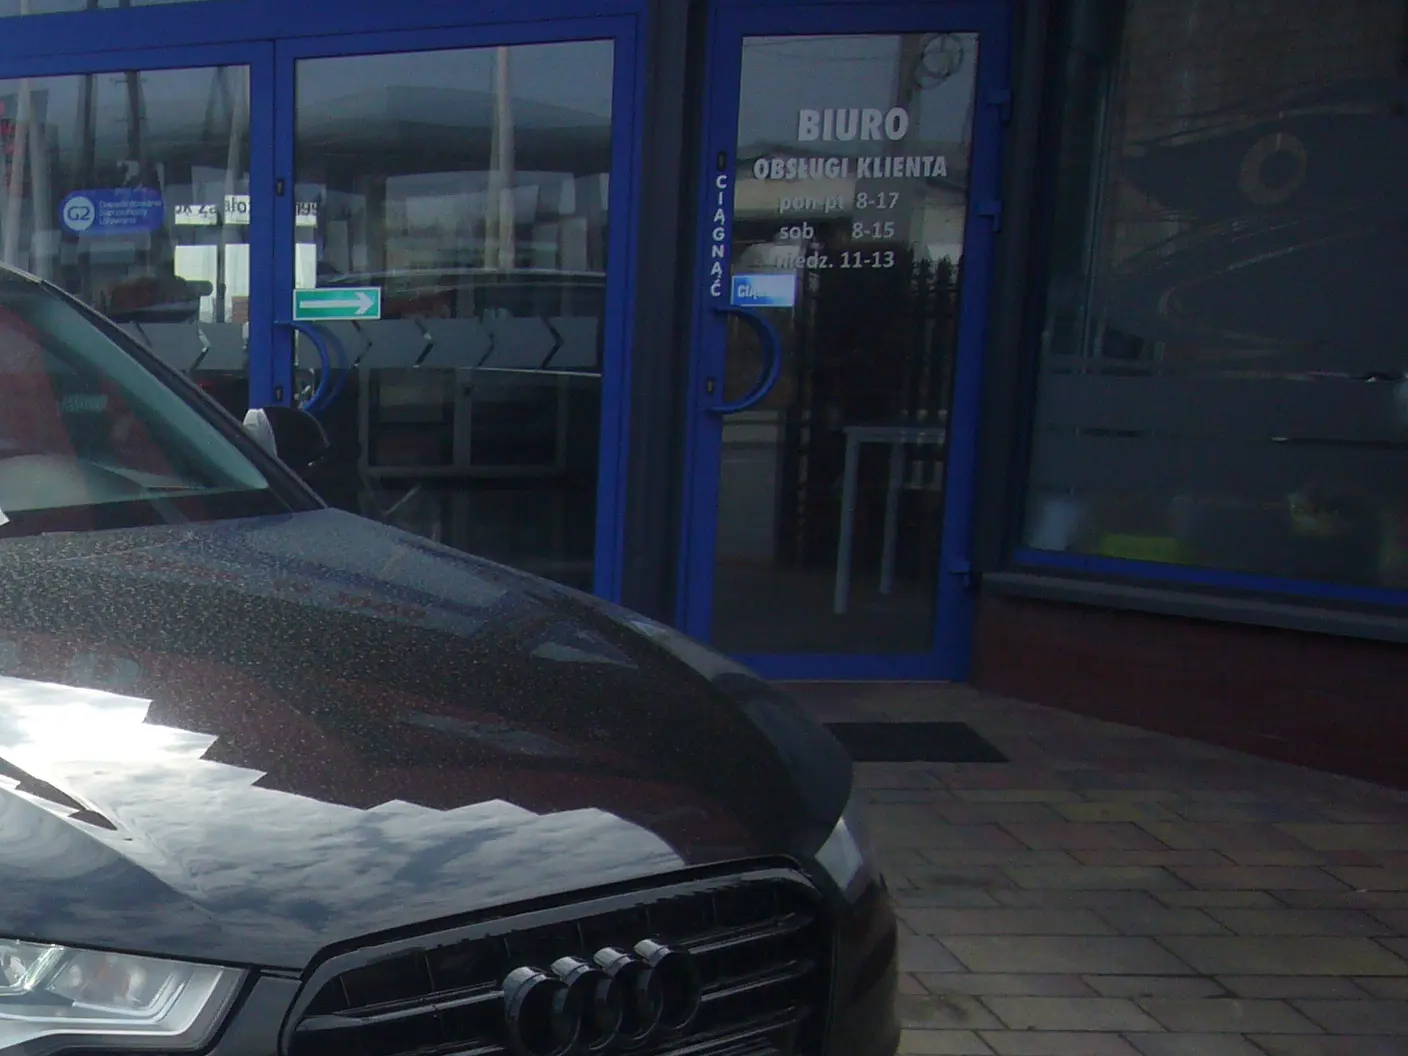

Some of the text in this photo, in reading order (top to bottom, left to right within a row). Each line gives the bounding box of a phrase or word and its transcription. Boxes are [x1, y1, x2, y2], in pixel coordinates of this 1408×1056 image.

[798, 107, 909, 142] BIURO
[753, 156, 947, 180] OBSŁUGI KLIENTA
[855, 192, 900, 209] 8-17
[67, 205, 92, 222] G2
[851, 221, 895, 239] 8-15
[840, 251, 895, 269] 11-13
